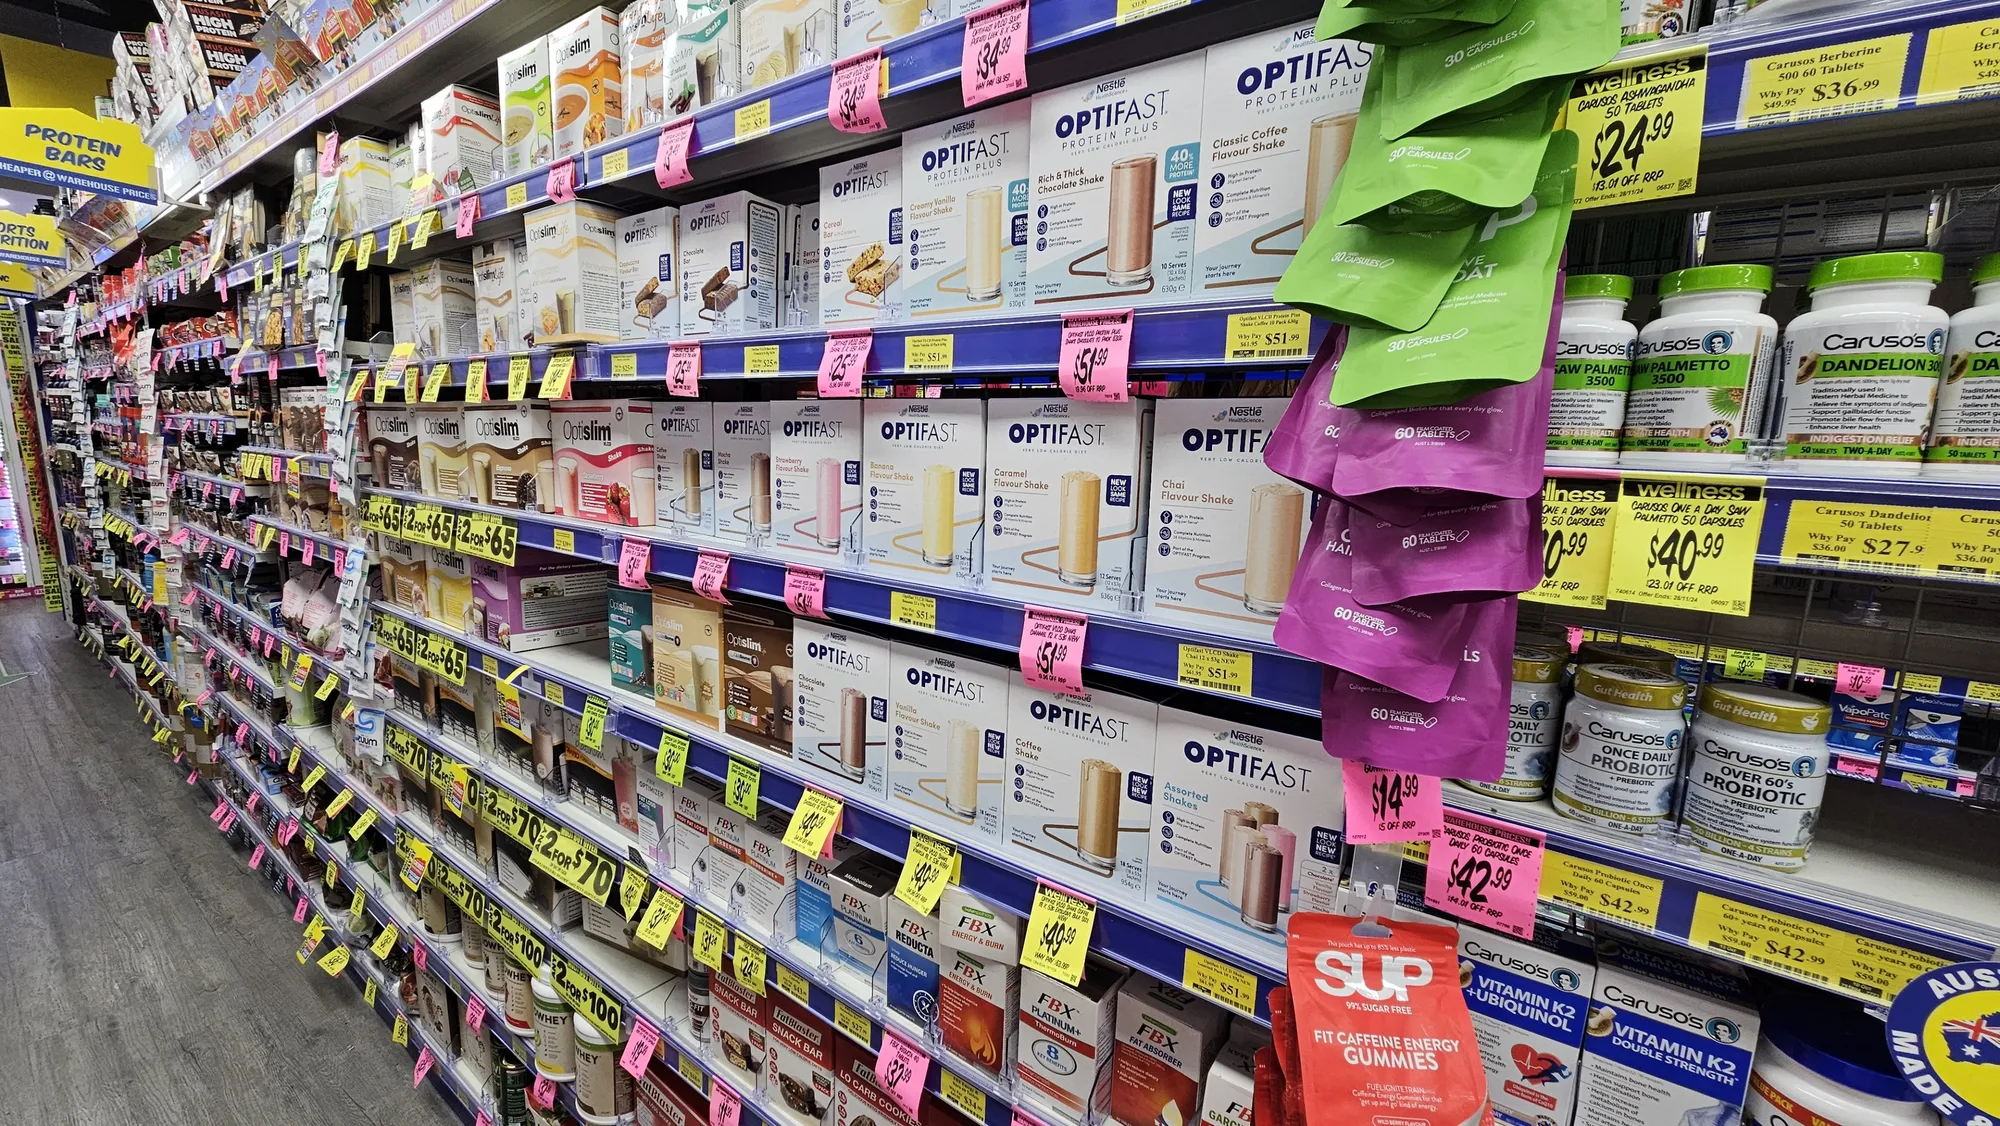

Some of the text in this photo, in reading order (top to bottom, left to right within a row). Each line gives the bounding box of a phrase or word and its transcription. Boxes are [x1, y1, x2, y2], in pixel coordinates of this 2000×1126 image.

[189, 6, 231, 18] MUSASHI
[192, 12, 234, 30] HIGH
[196, 24, 237, 38] PROTEIN
[555, 36, 591, 64] Optislim
[1444, 50, 1465, 69] 30
[1466, 30, 1517, 57] CAPSULES
[1767, 46, 1882, 71] Carusos Berberine
[1584, 59, 1691, 95] wellness
[1778, 61, 1864, 81] 500 60 Tablets
[1096, 78, 1126, 94] Nestlé
[1578, 78, 1695, 112] CARUSOS ASHWAGANDHA
[1759, 86, 1806, 100] Why Pay
[1812, 78, 1880, 102] $36.99
[1258, 88, 1359, 115] VERY LOW CALORIE DIET
[1605, 98, 1664, 119] 50 TABLETS
[1764, 98, 1797, 110] $49.95
[1056, 89, 1169, 138] OPTIFAST
[25, 124, 122, 157] PROTEIN
[1213, 125, 1288, 149] Classic Coffee
[1591, 111, 1674, 180] $24.99
[45, 147, 106, 171] BARS
[1212, 139, 1285, 162] Flavour Shake
[0, 161, 156, 200] HEAPER @ WAREHOUSE PRICES
[1038, 167, 1084, 184] Rich & Thick
[1038, 175, 1104, 194] Chocolate Shake
[1592, 170, 1664, 191] $13.01 OFF RRP
[910, 195, 956, 211] Creamy Vanilla
[1173, 189, 1192, 198] NEW
[1173, 197, 1191, 205] LOOK
[1619, 188, 1643, 197] 28/11/24
[910, 206, 953, 220] Flavour Shake
[1172, 203, 1191, 211] SAME
[824, 219, 842, 229] Cereal
[1205, 263, 1241, 273] Your journey
[1205, 272, 1220, 280] starts
[1265, 333, 1299, 346] $51.99
[1823, 333, 1926, 350] Caruso's
[1651, 359, 1730, 373] PALMETTO
[1822, 359, 1926, 372] DANDELION
[1651, 374, 1685, 384] 3500
[1371, 409, 1395, 418] Collagen
[563, 420, 611, 444] Optislim
[1009, 423, 1105, 445] OPTIFAST
[1395, 427, 1455, 439] 60 TABLETS
[1810, 435, 1914, 445] INDIGESTION RELIEF
[1843, 447, 1892, 456] TWO-A-DAY
[994, 469, 1027, 479] Caramel
[994, 479, 1049, 490] Flavour Shake
[1163, 480, 1185, 490] Chai
[1631, 501, 1752, 515] CARUSOS ONE A DAY SAW
[1633, 513, 1744, 528] PALMETTO 50 CAPSULES
[463, 519, 515, 559] 2 FOR $65
[1809, 532, 1855, 543] Why Pay
[1812, 544, 1846, 552] $36.00
[1647, 528, 1724, 581] $40.99
[1713, 700, 1778, 722] Gut Health
[1591, 754, 1675, 776] PROBIOTIC
[1602, 746, 1674, 763] ONCE DAILY
[1704, 740, 1791, 772] Caruso's
[1184, 741, 1311, 792] OPTIFAST
[1721, 765, 1793, 789] OVER 60's
[1164, 782, 1208, 803] Assorted
[1372, 773, 1418, 822] $14.99
[1704, 773, 1806, 805] PROBIOTIC
[1163, 792, 1198, 811] Shakes
[1444, 815, 1493, 836] WAREHOUSE
[539, 830, 612, 896] 2 FOR $70
[1447, 853, 1512, 902] $42.99
[1563, 860, 1654, 891] Carusos Probiotic Once
[901, 919, 930, 940] FBX
[952, 930, 976, 944] ENERGY
[985, 939, 1004, 950] BURN
[895, 930, 934, 958] REDUCTA
[1465, 941, 1549, 980] Caruso's
[1315, 951, 1433, 1002] SUP
[556, 962, 619, 1033] 2 FOR $100
[1479, 975, 1576, 1019] VITAMIN K2
[1346, 1002, 1412, 1014] 99% SUGAR FREE
[1467, 988, 1572, 1033] +UBIQUINOL
[1032, 1006, 1081, 1036] PLATINUM+
[772, 1023, 823, 1061] SNACK BAR
[1034, 1020, 1077, 1048] ThermoBurn
[1314, 1030, 1459, 1052] FIT CAFFEINE ENERGY
[1129, 1036, 1182, 1069] FAT ABSORBER
[1344, 1048, 1439, 1070] GUMMIES
[1615, 1022, 1736, 1076] VITAMIN K2
[1612, 1036, 1736, 1086] DOUBLE STRENGTH
[1892, 1029, 1963, 1115] MADE
